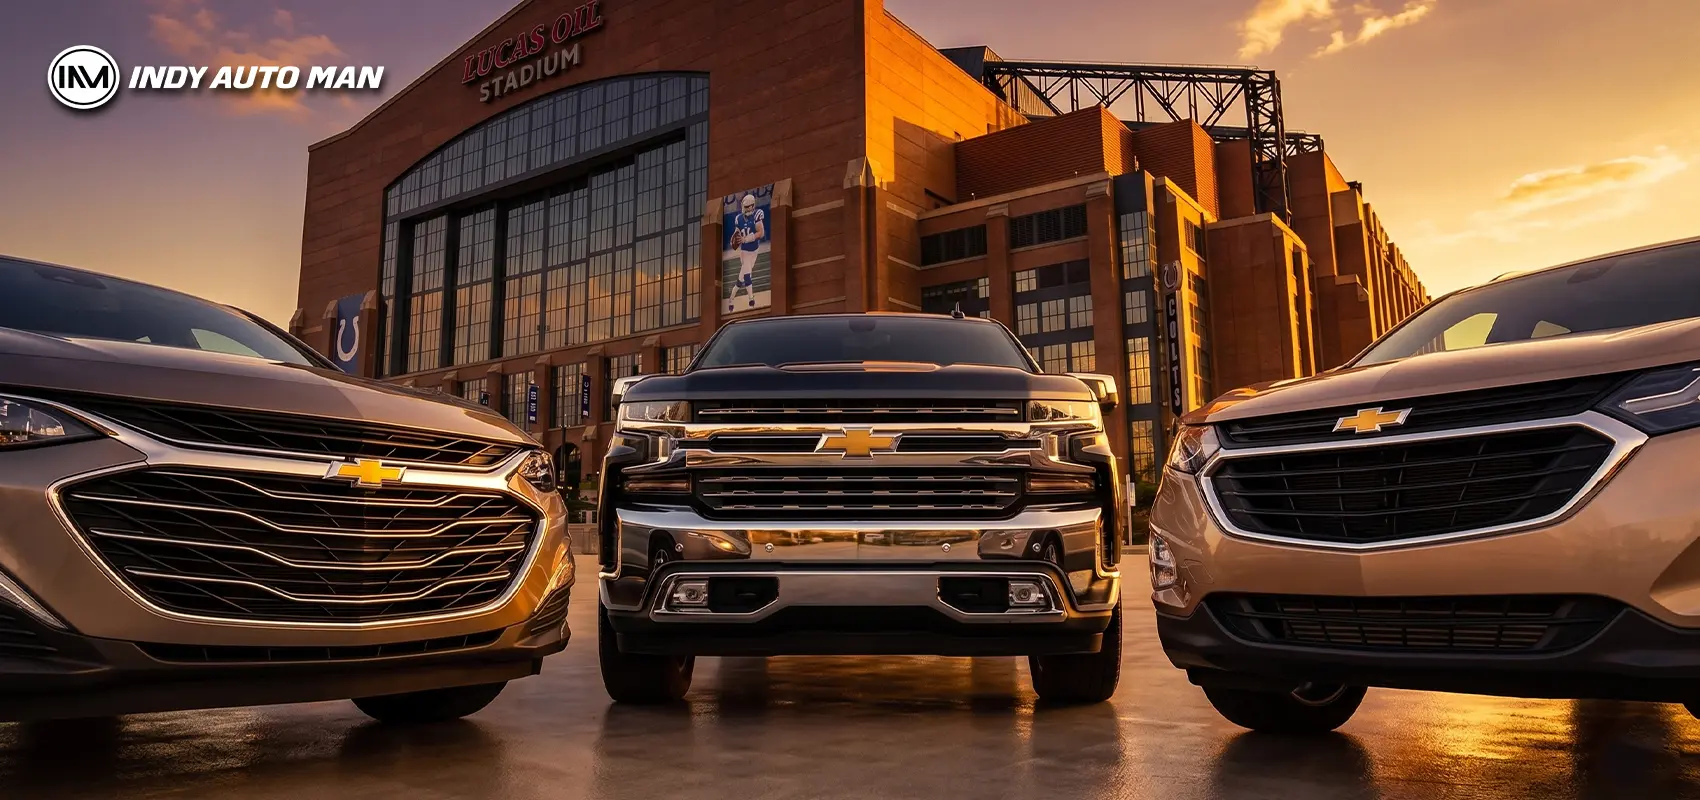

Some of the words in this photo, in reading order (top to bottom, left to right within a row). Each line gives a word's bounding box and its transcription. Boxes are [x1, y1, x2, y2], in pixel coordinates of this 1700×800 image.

[461, 23, 545, 84] LUCAS
[551, 0, 602, 44] OIL
[479, 43, 581, 102] STADIUM
[1169, 299, 1180, 406] COLTS
